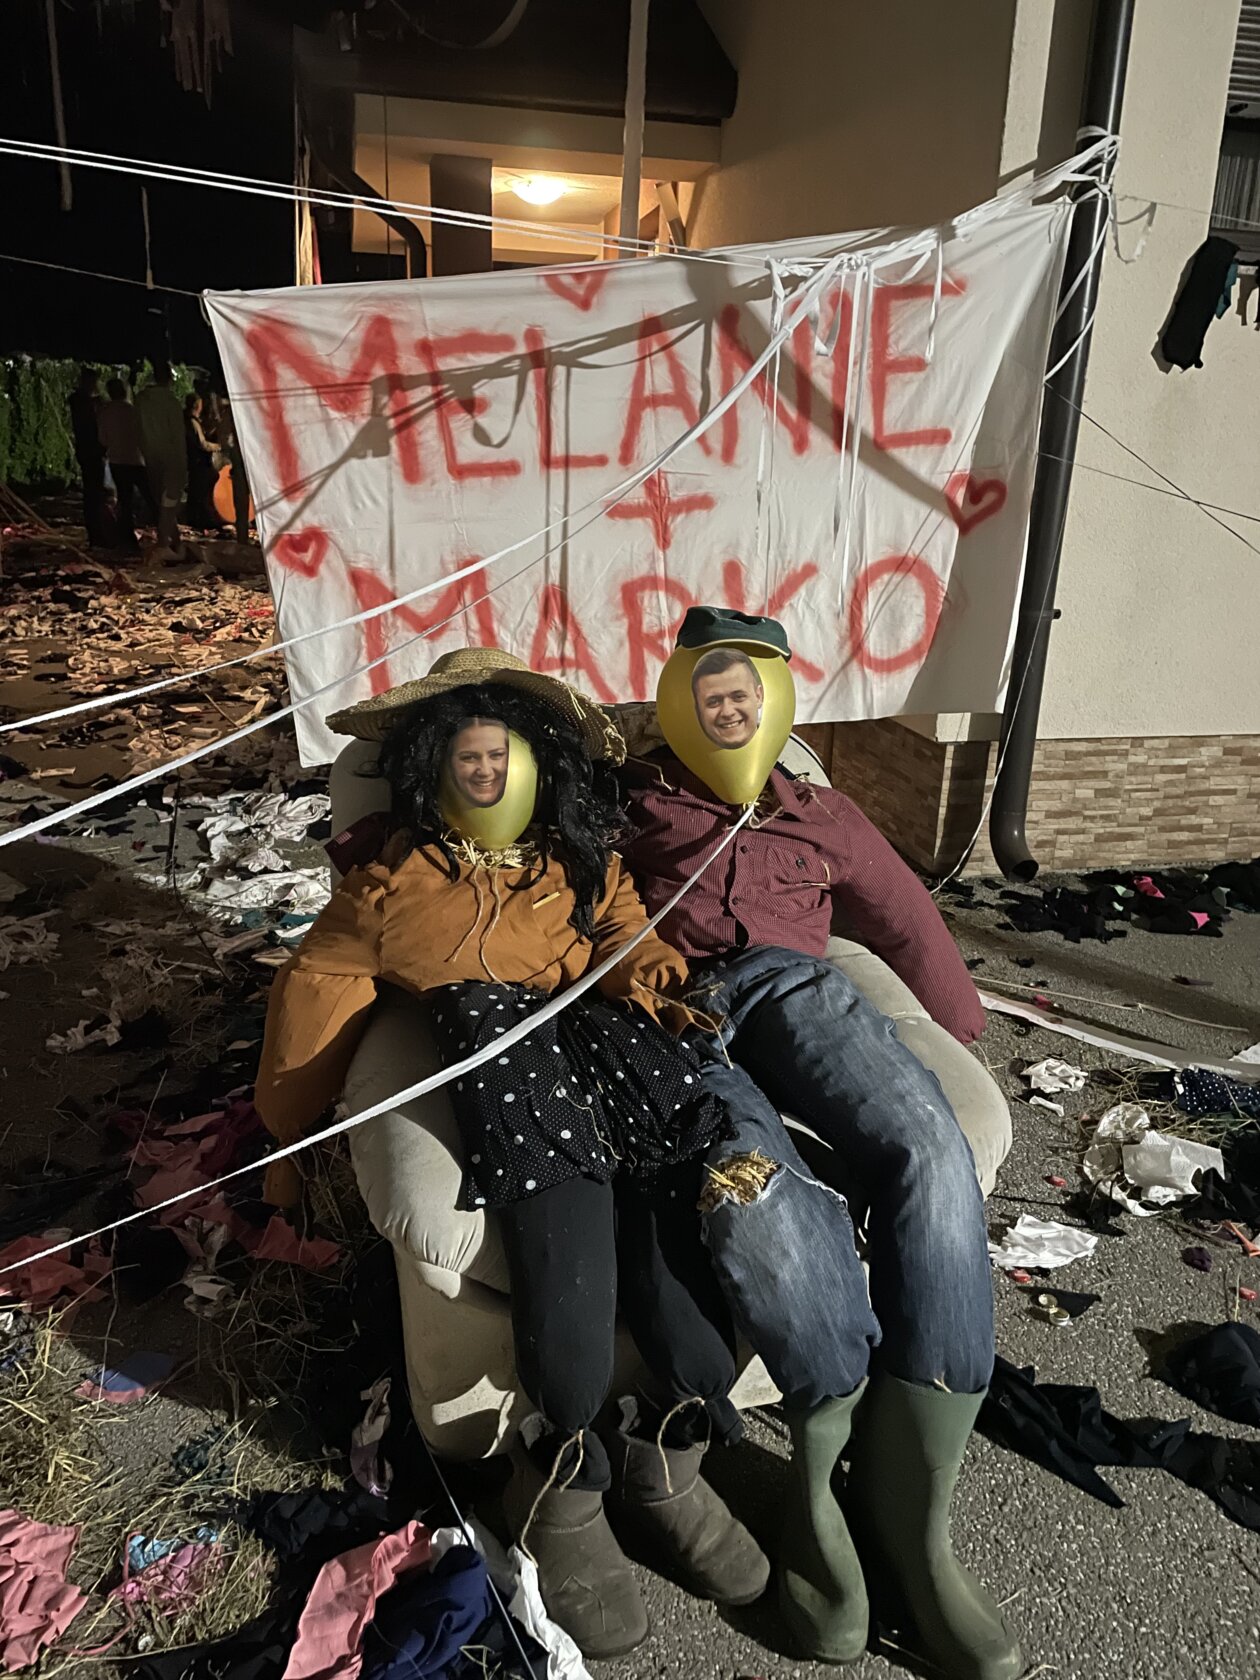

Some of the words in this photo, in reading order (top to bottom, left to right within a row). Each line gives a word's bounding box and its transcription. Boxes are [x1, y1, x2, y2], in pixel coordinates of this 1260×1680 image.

[246, 278, 967, 502] MELANIE
[605, 468, 715, 550] +
[350, 554, 945, 703] MARKO
